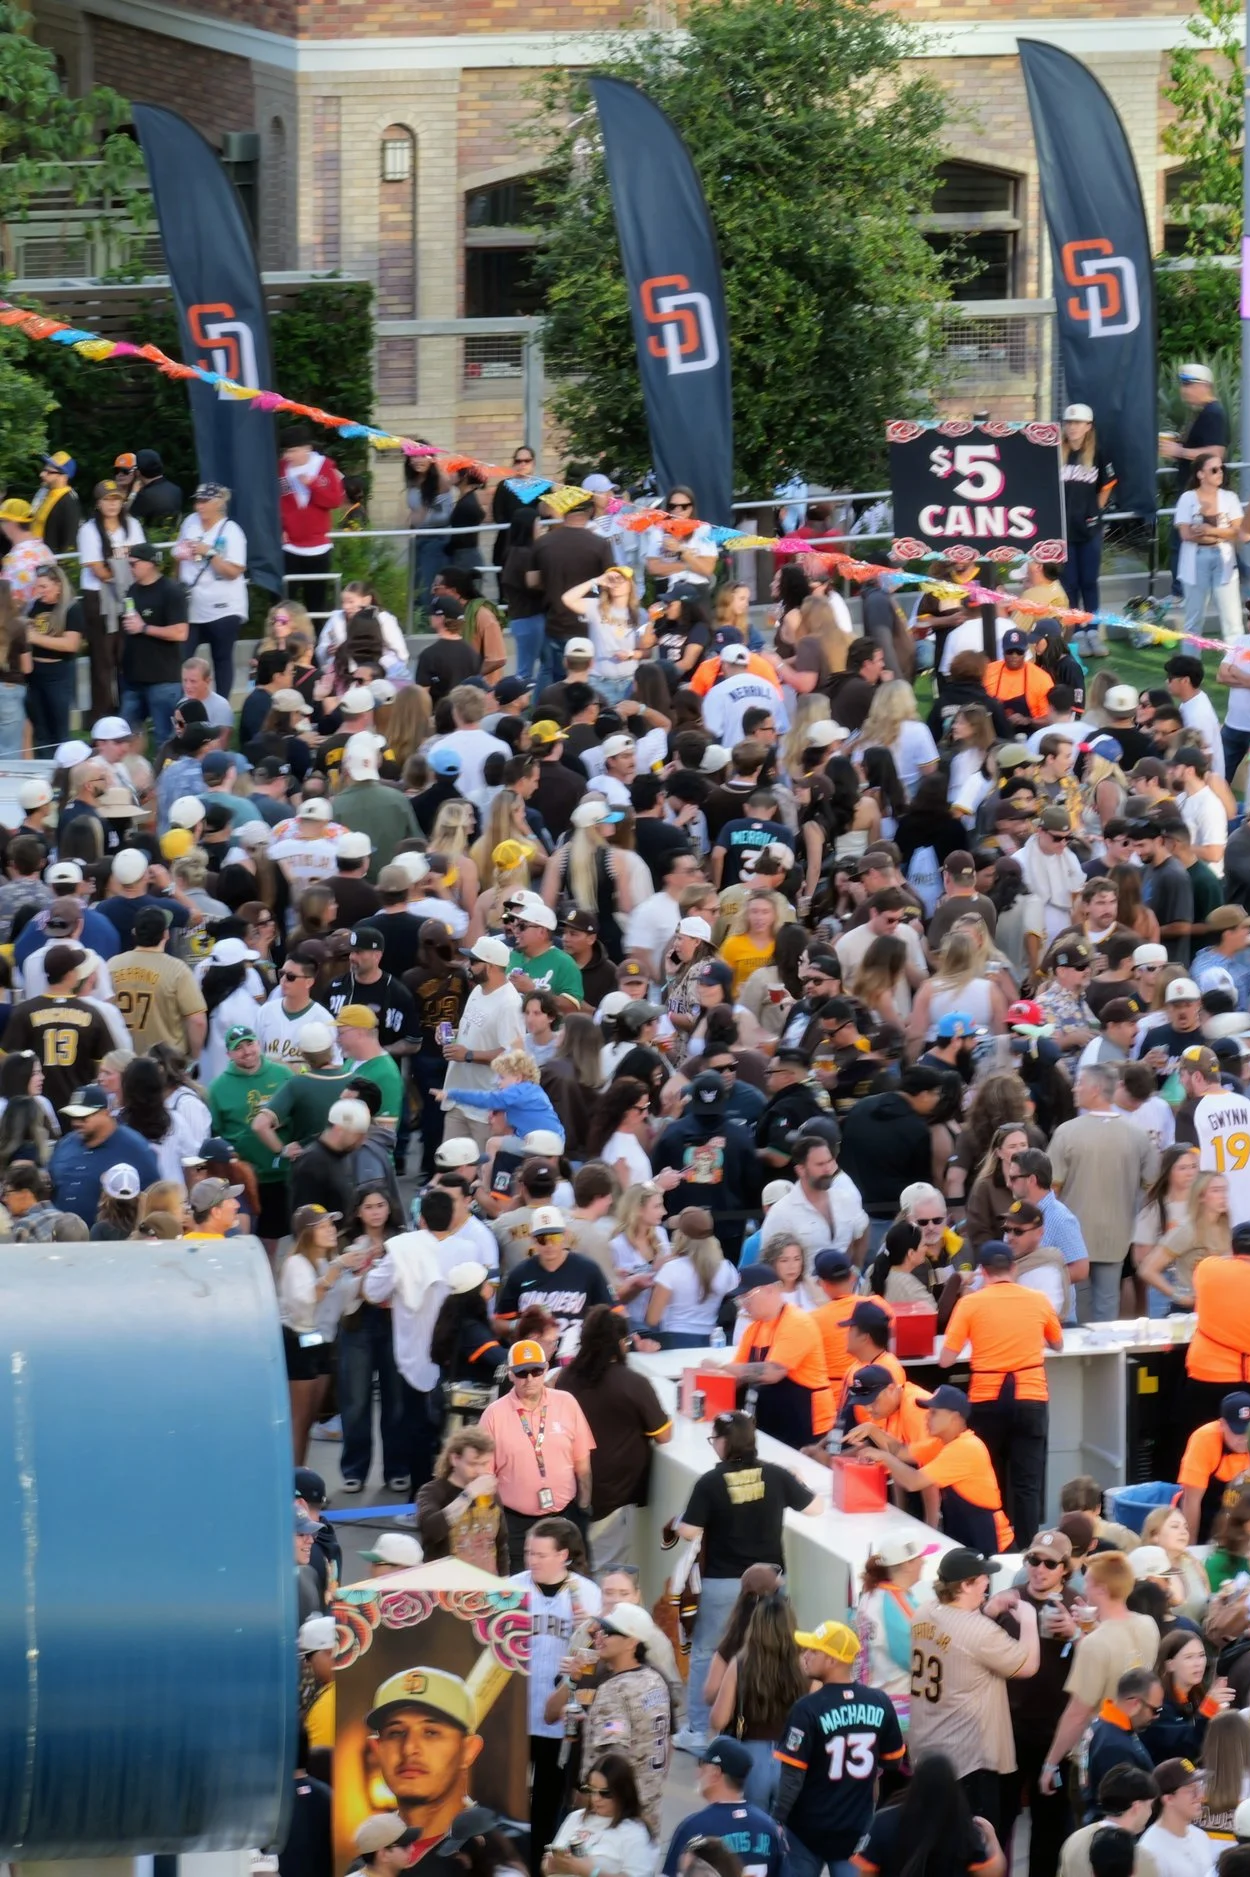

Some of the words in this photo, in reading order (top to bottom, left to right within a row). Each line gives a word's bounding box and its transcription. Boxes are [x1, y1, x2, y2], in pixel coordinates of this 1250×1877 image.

[1062, 238, 1141, 339] SD
[640, 275, 719, 375] SD
[929, 443, 1006, 503] $5
[917, 503, 1038, 539] CANS
[116, 990, 152, 1030] 27
[42, 1028, 79, 1067] 13
[1207, 1107, 1248, 1132] GWYNN
[910, 1647, 943, 1705] 23
[820, 1703, 885, 1735] MACHADO
[825, 1731, 877, 1781] 13
